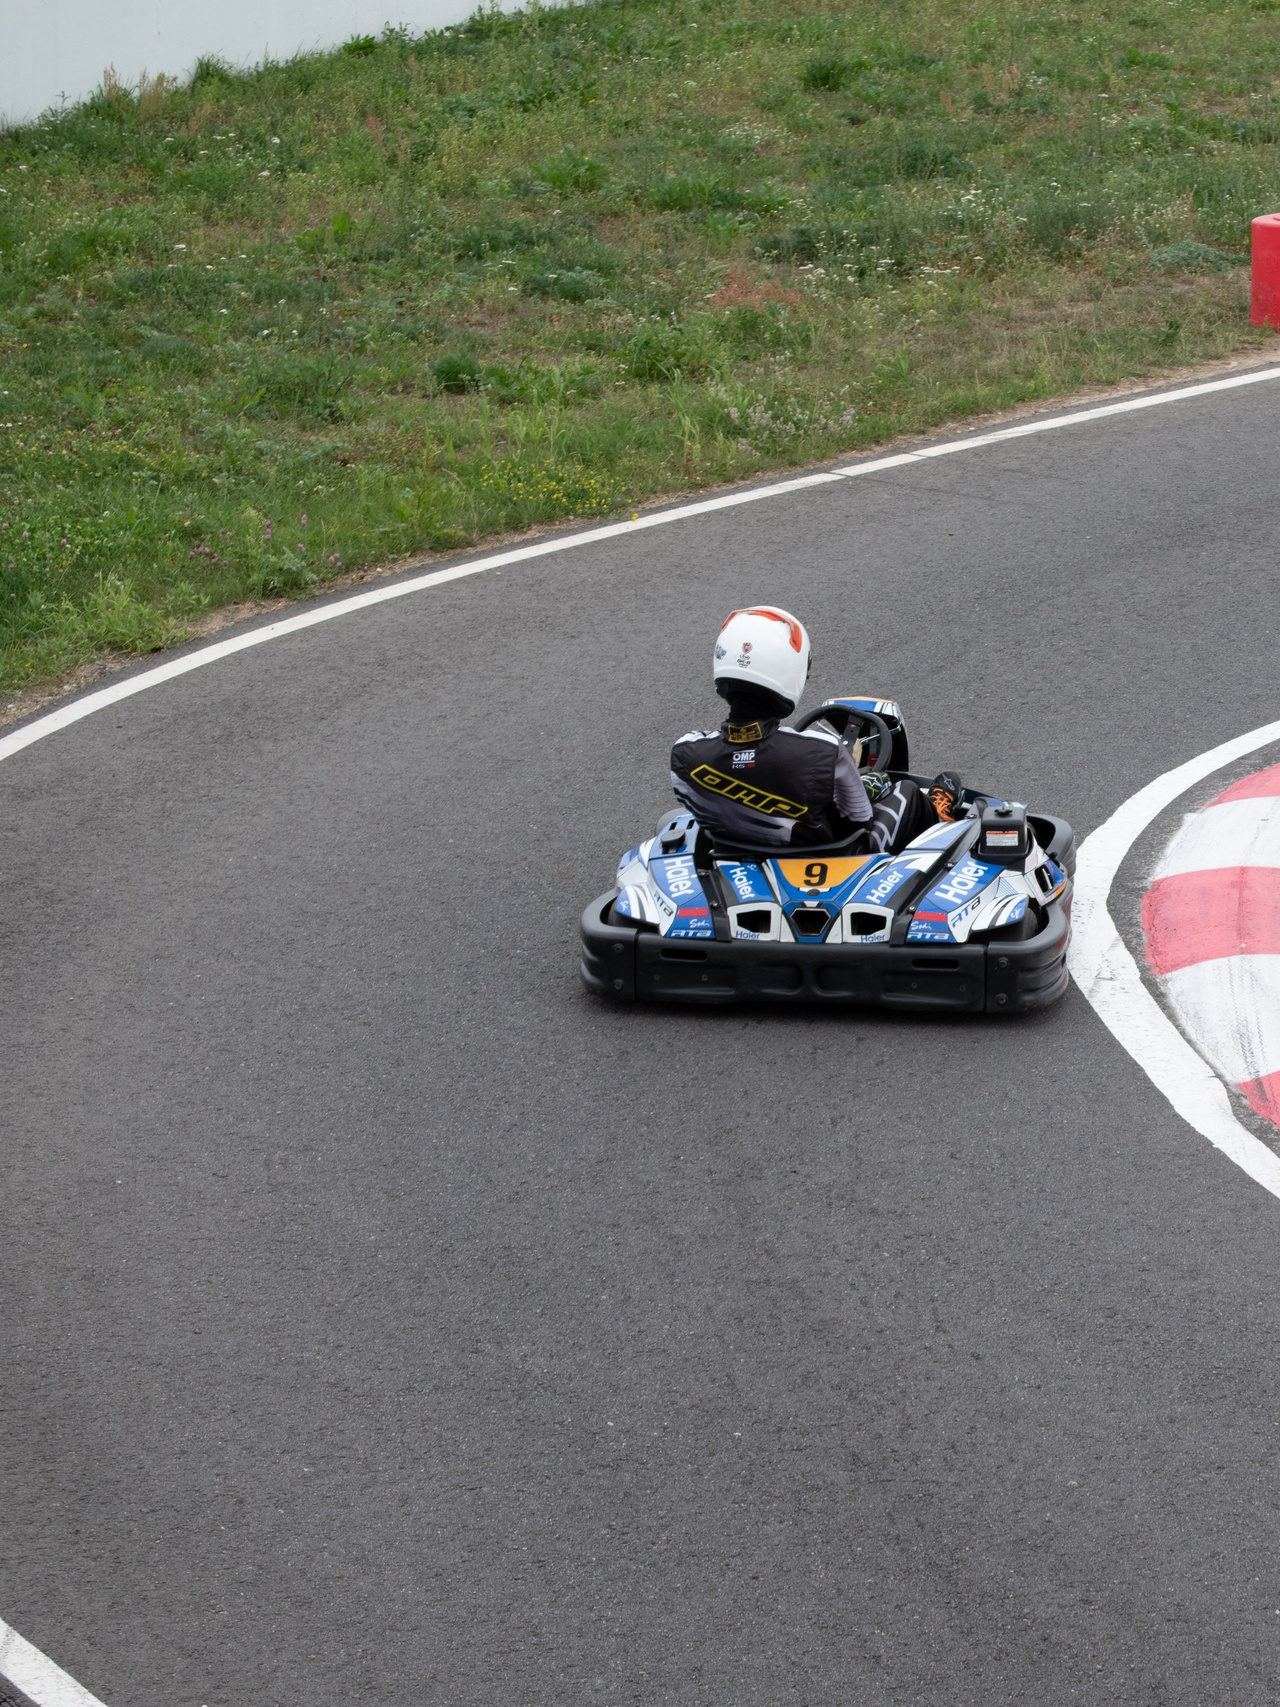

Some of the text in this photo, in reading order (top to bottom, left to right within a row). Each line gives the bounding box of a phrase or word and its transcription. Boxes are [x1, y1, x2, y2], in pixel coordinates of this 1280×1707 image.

[732, 752, 755, 762] OMP
[663, 855, 698, 898] Haier
[729, 866, 755, 901] Haier
[803, 862, 828, 887] 9
[935, 860, 989, 904] Haier
[866, 869, 904, 904] Haier
[689, 918, 711, 929] Sodi
[910, 920, 933, 931] Sodi
[735, 930, 761, 940] Haier
[860, 934, 886, 943] Haier
